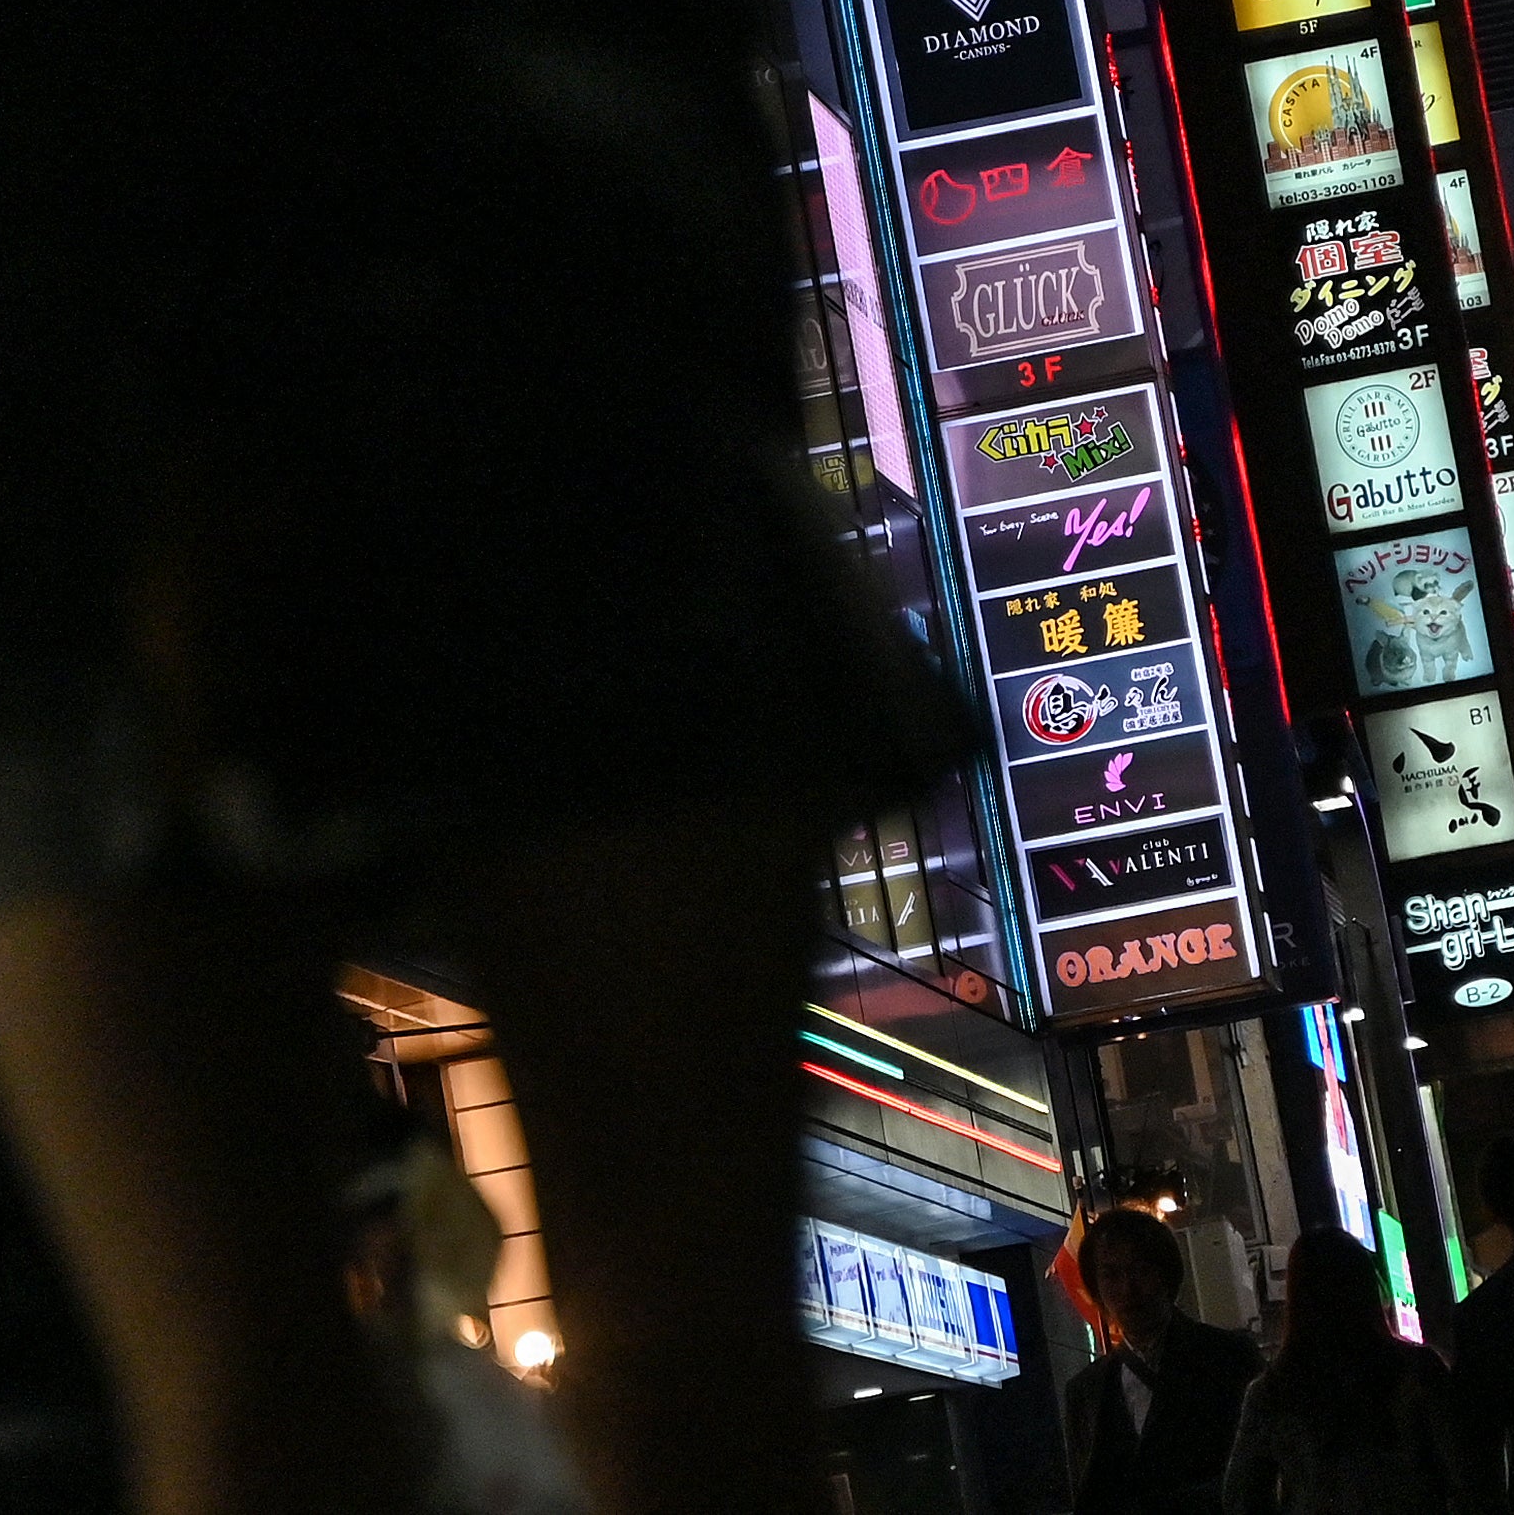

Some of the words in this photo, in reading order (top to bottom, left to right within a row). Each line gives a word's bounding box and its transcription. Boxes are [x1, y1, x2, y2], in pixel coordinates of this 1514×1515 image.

[924, 15, 1040, 54] DIAMOND
[1299, 19, 1319, 35] 5F
[1360, 46, 1378, 59] 4F
[1283, 78, 1321, 128] CASITA
[1278, 174, 1396, 206] tel:03-3200-1103
[1306, 210, 1380, 243] 隠れ家
[1295, 231, 1404, 282] 個室
[973, 262, 1081, 338] GLÜCK
[1289, 259, 1417, 313] ダイニング
[1294, 298, 1360, 346] Domo
[1324, 310, 1385, 349] Domo
[1397, 324, 1429, 350] 3F
[1336, 341, 1396, 363] 03-6273-8378
[1018, 355, 1062, 386] 3F
[1409, 369, 1437, 391] 2F
[1343, 406, 1358, 443] GRILL
[1357, 391, 1381, 405] BAR
[1395, 398, 1413, 431] MEAT
[1059, 421, 1134, 483] Mix!
[1357, 444, 1406, 463] GARDEN
[1327, 466, 1456, 524] Gabutto
[1063, 487, 1151, 572] Yes!
[1345, 543, 1472, 594] ペットショップ
[1006, 591, 1061, 617] 隠れ家
[1079, 581, 1118, 603] 和処
[1470, 705, 1492, 726] B1
[1074, 793, 1166, 824] ENVI
[1109, 842, 1208, 875] VALENTI
[1142, 838, 1169, 851] club
[1405, 892, 1490, 933] Shan
[1057, 923, 1238, 987] ORANGE
[1466, 983, 1502, 1004] B-2
